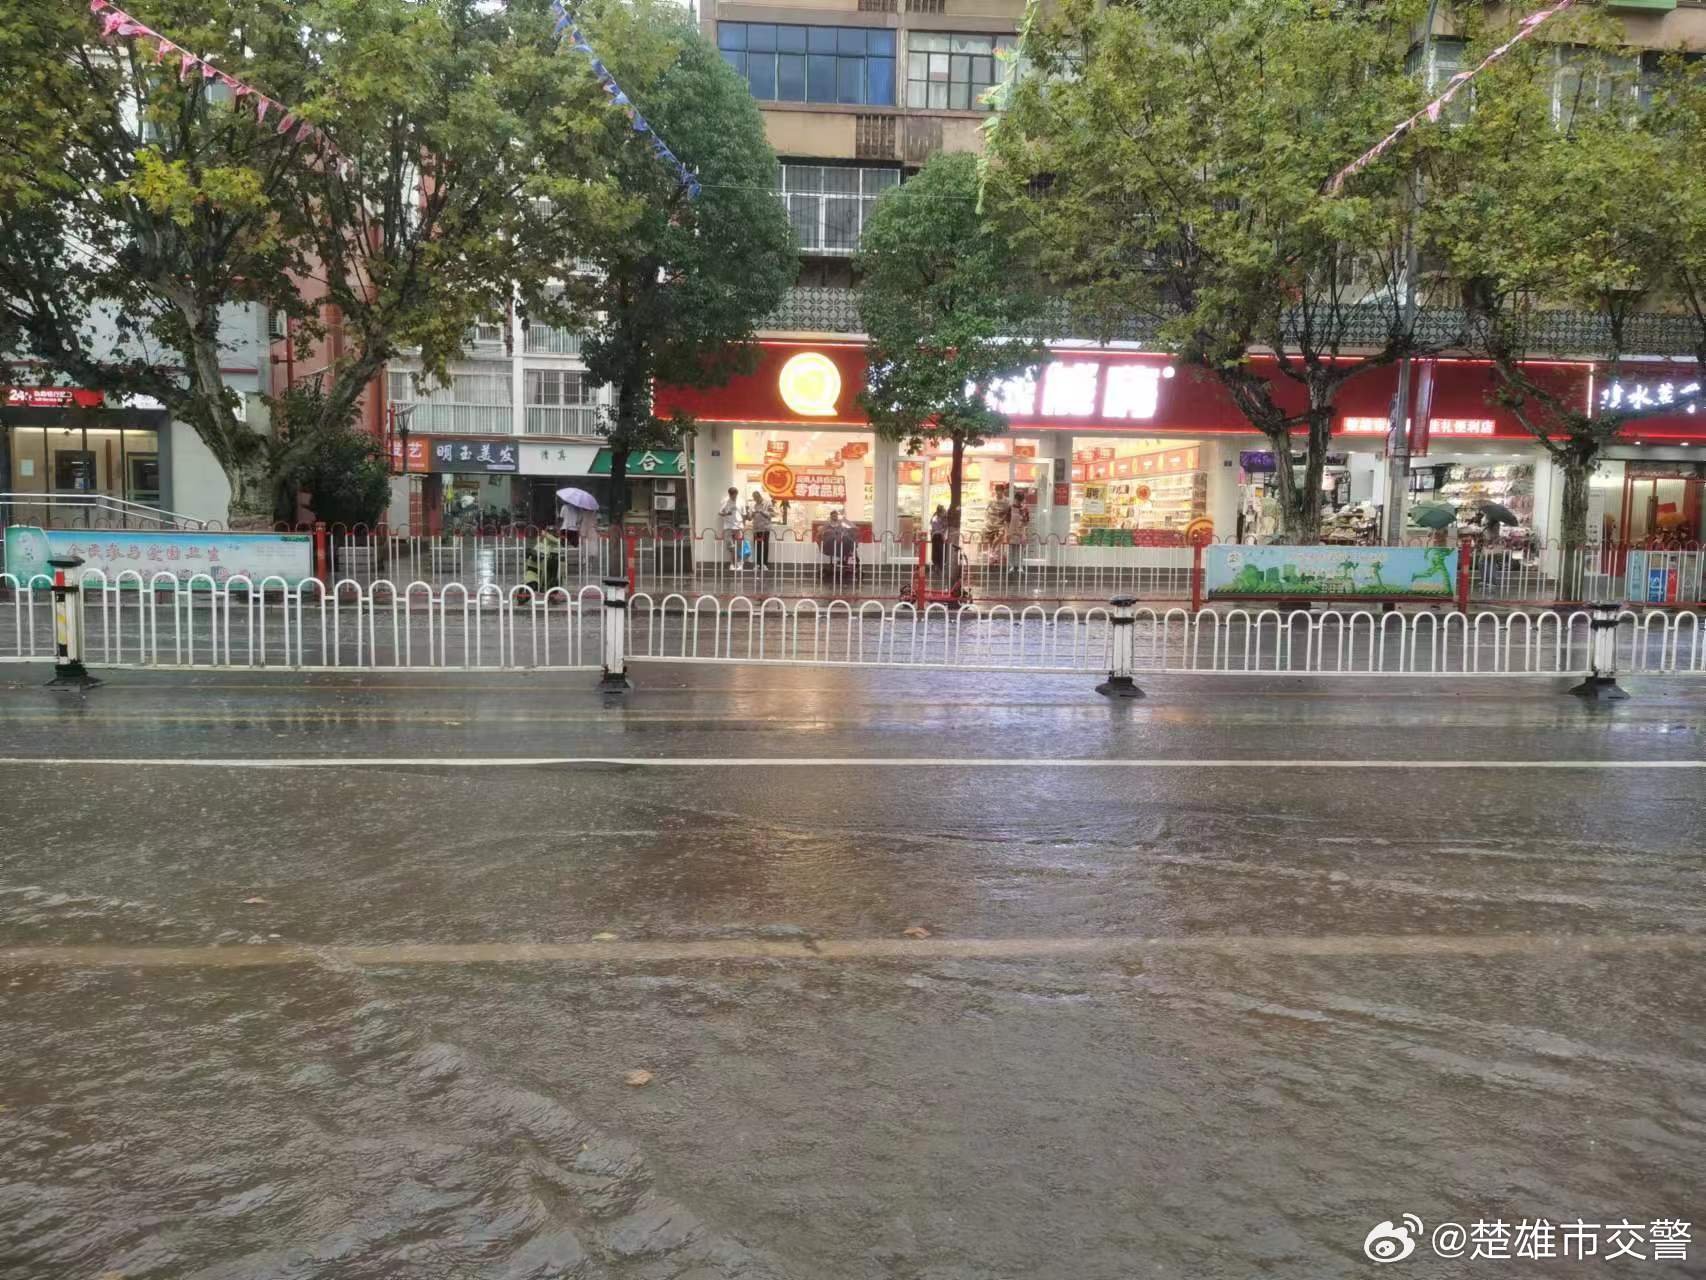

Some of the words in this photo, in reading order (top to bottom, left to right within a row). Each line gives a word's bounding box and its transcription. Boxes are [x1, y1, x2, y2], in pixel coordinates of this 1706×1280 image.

[437, 444, 515, 463] 明玉美发
[795, 483, 845, 497] 零食品牌
